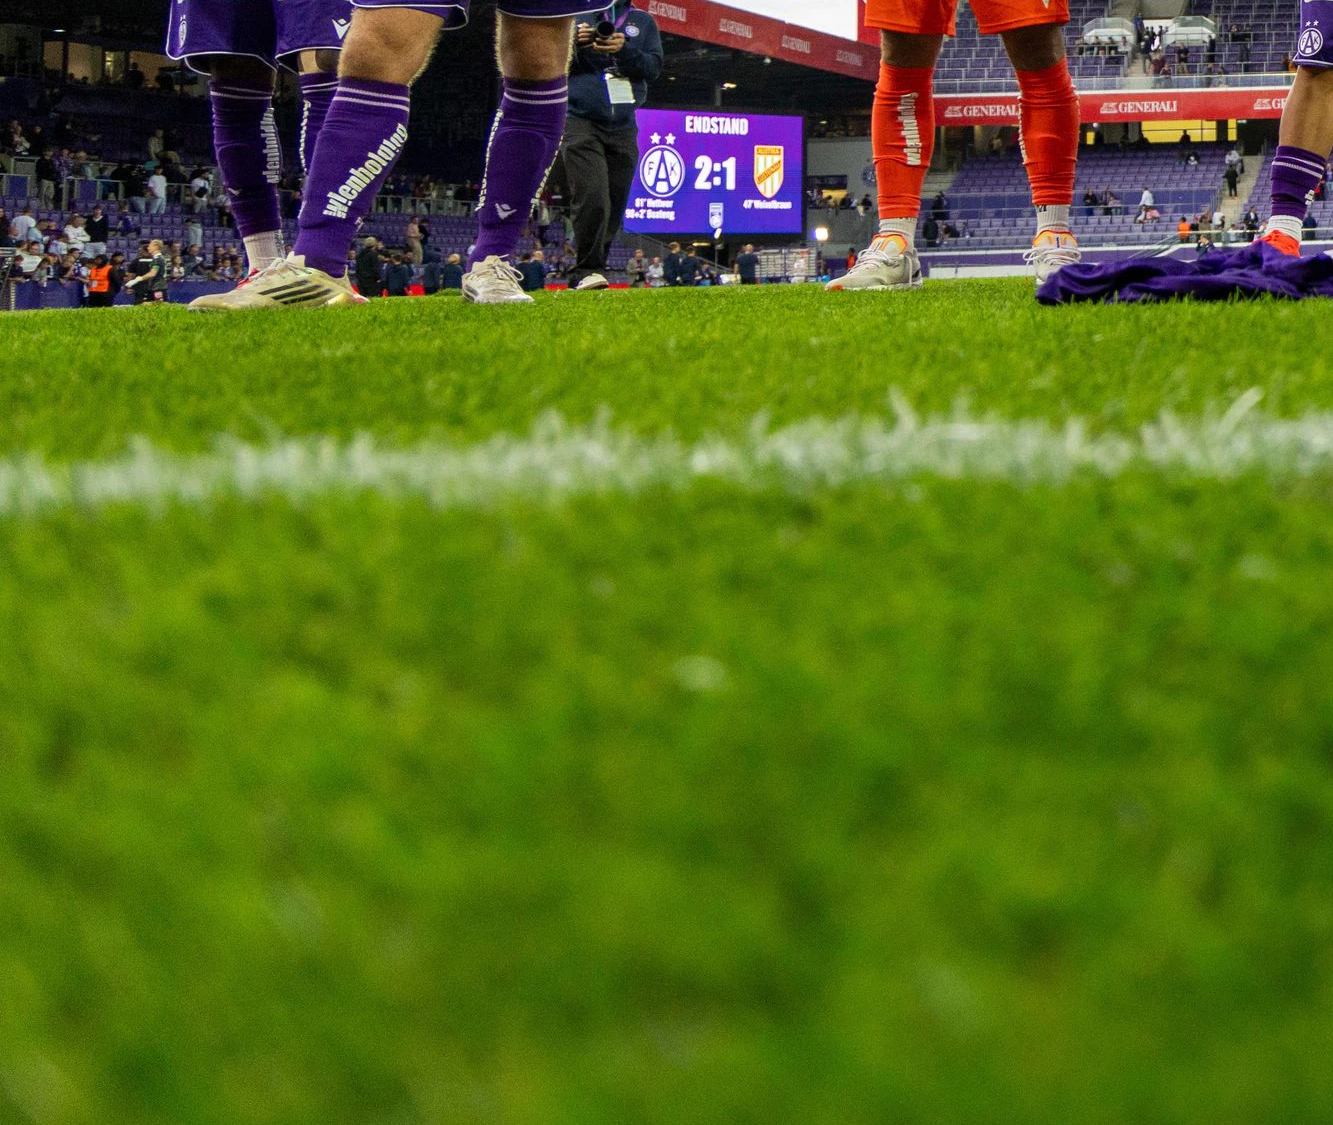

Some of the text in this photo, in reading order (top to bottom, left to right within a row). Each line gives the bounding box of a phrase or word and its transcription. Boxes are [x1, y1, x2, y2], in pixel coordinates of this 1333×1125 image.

[656, 2, 687, 22] GENERALI
[963, 105, 1021, 118] GENERAL
[1118, 100, 1178, 114] GENERALI
[685, 115, 749, 135] ENDSTAND
[694, 154, 737, 191] 2:1
